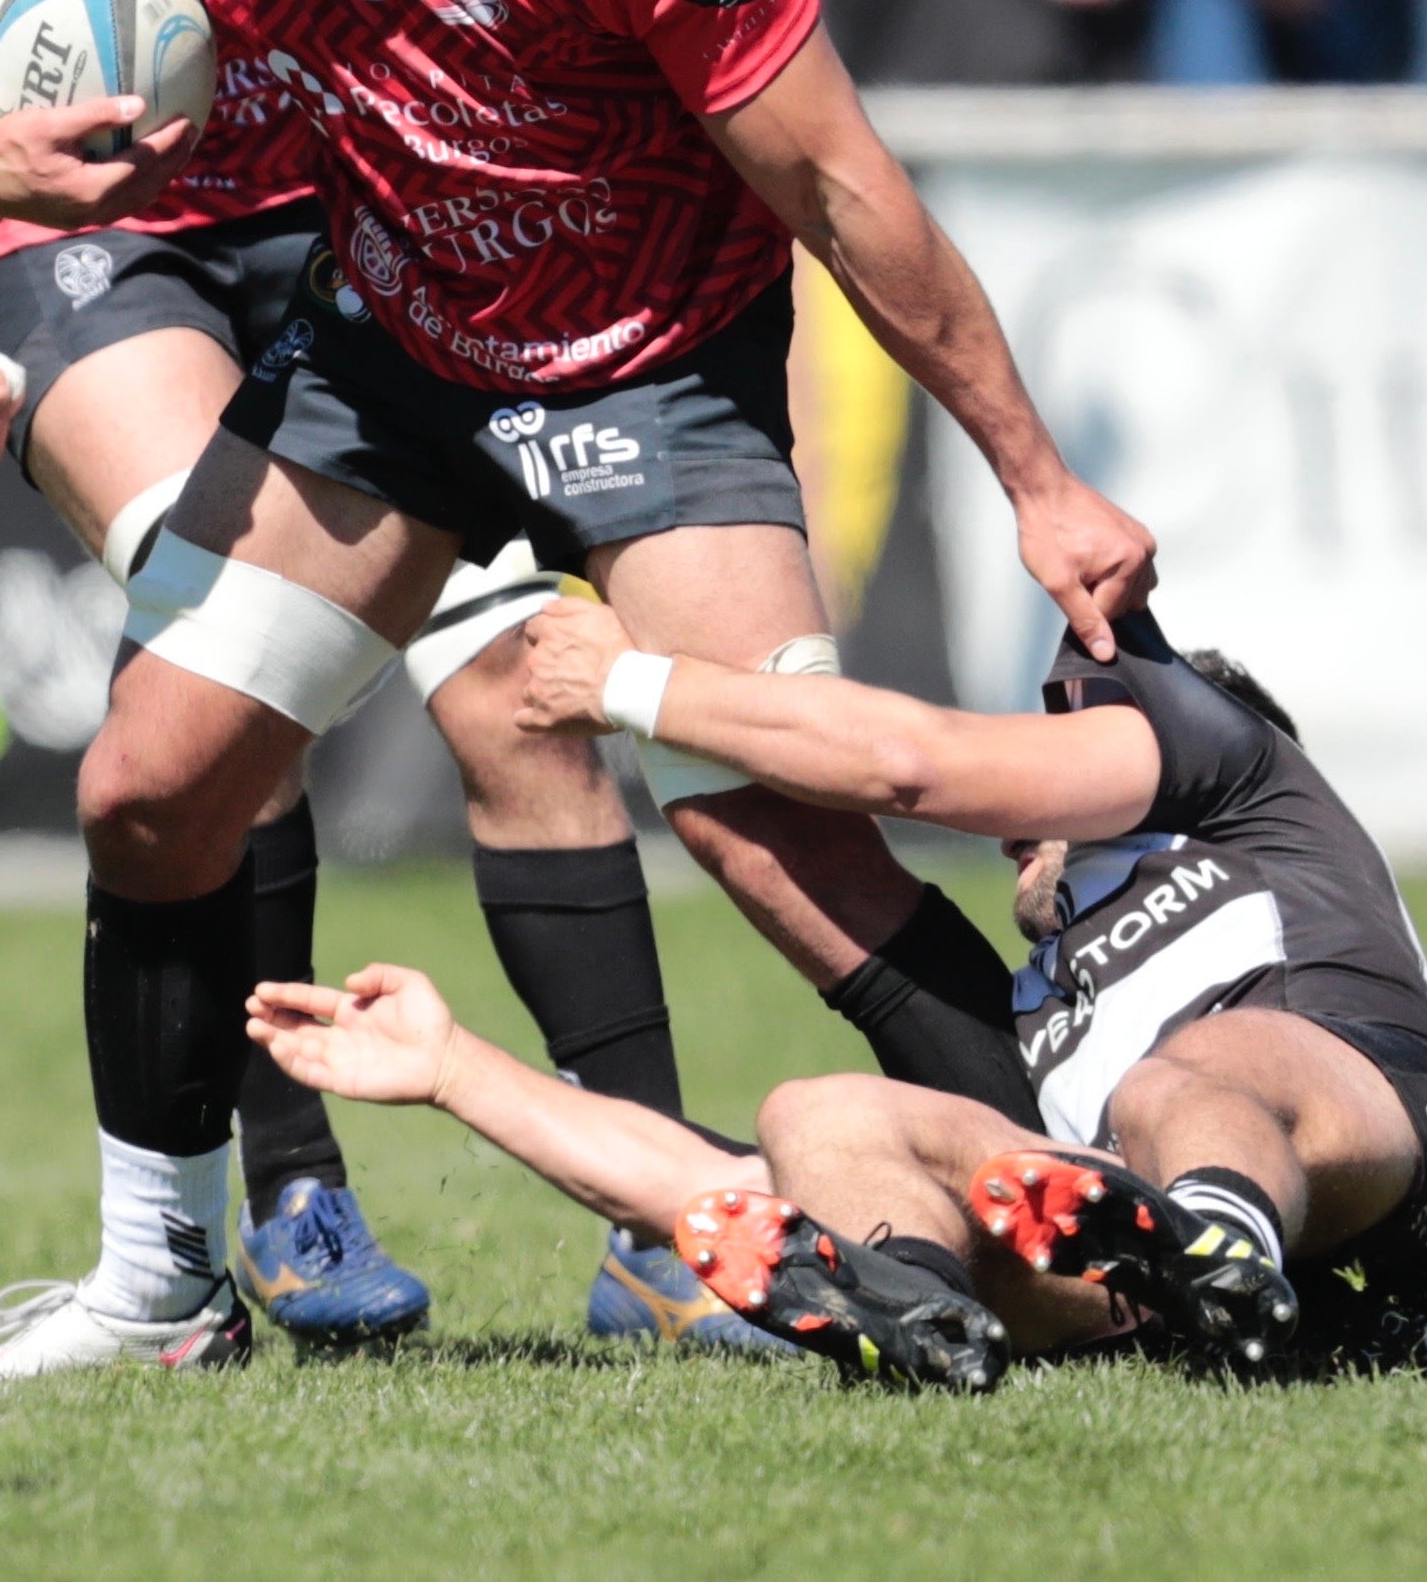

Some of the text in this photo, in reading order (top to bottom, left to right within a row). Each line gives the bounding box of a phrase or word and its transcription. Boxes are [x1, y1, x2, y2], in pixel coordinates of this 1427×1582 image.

[408, 300, 443, 339] de
[549, 422, 640, 471] rfs
[560, 465, 614, 483] empresa
[563, 472, 645, 497] constructora
